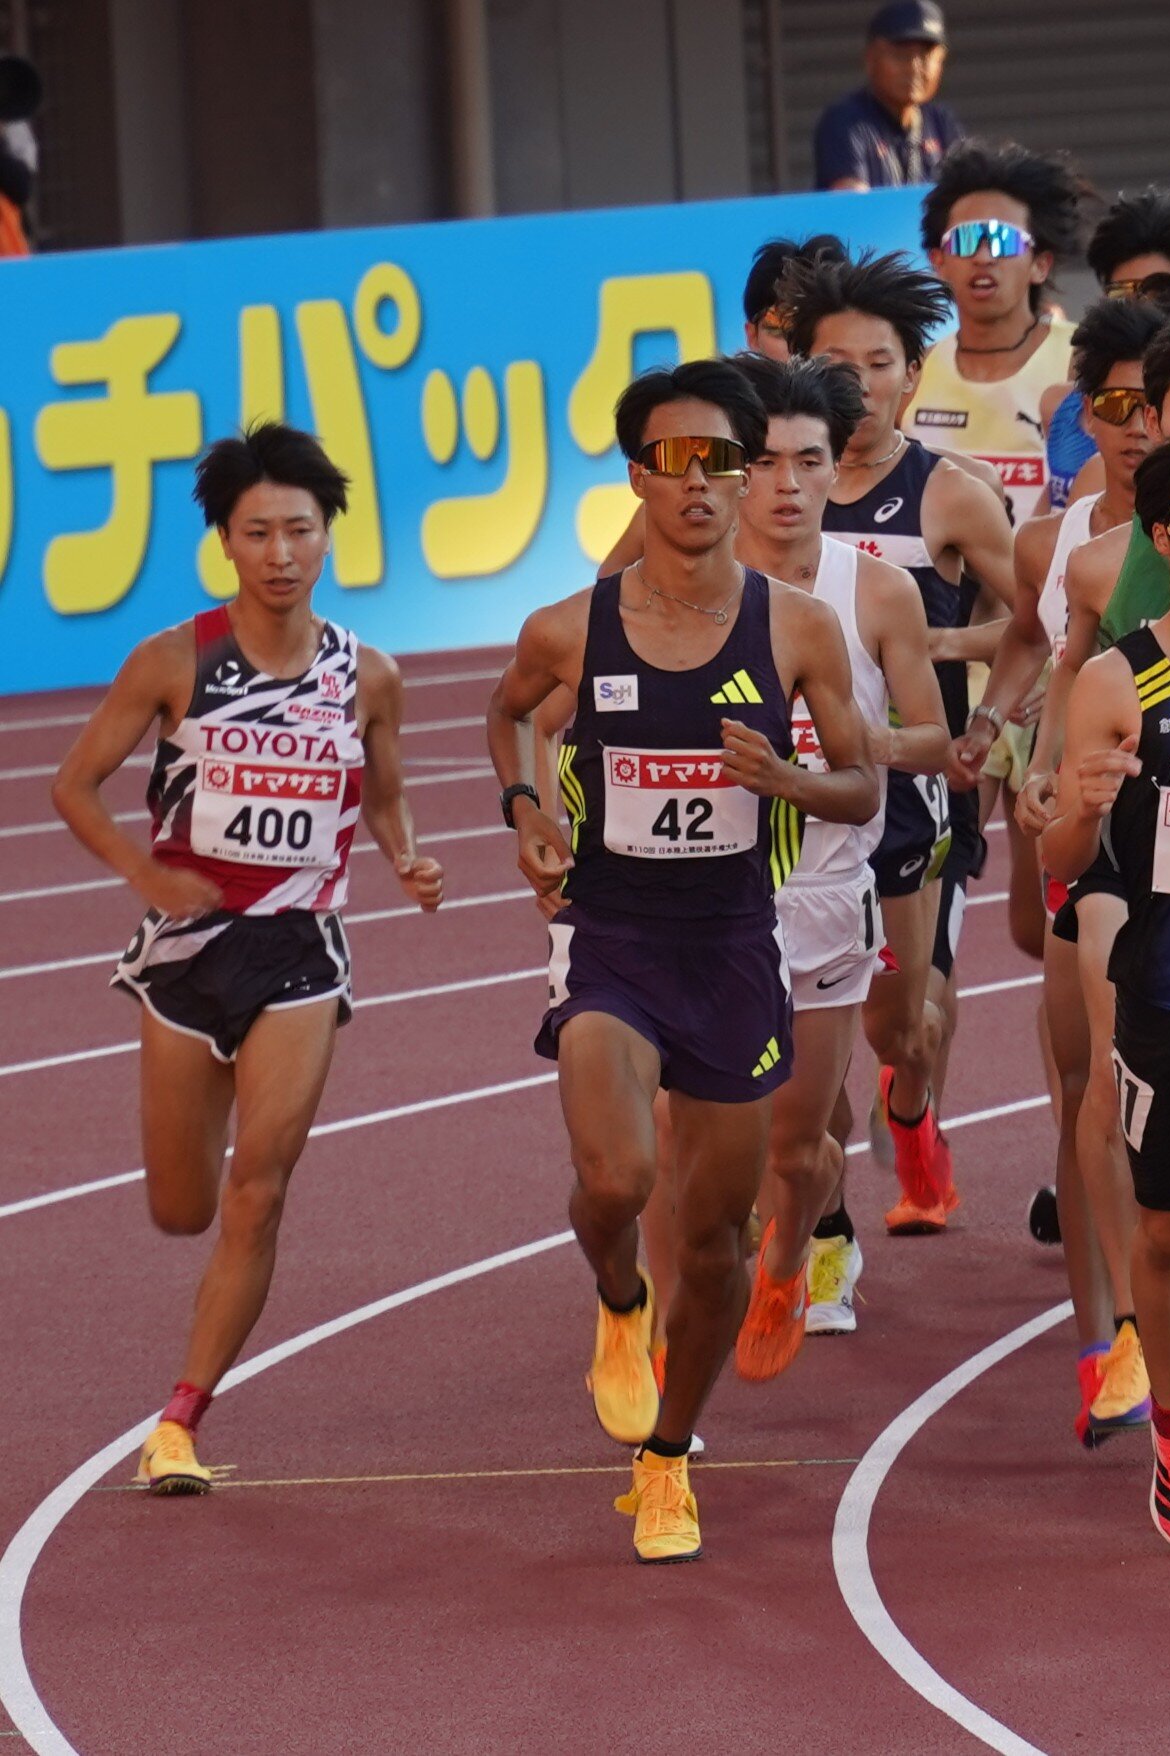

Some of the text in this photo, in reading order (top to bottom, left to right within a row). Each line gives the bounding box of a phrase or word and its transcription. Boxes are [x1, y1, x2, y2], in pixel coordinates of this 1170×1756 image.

[0, 261, 718, 614] チパック
[200, 726, 339, 763] TOYOTA
[239, 770, 336, 795] ヤマザキ
[224, 805, 313, 850] 400
[651, 798, 714, 841] 42
